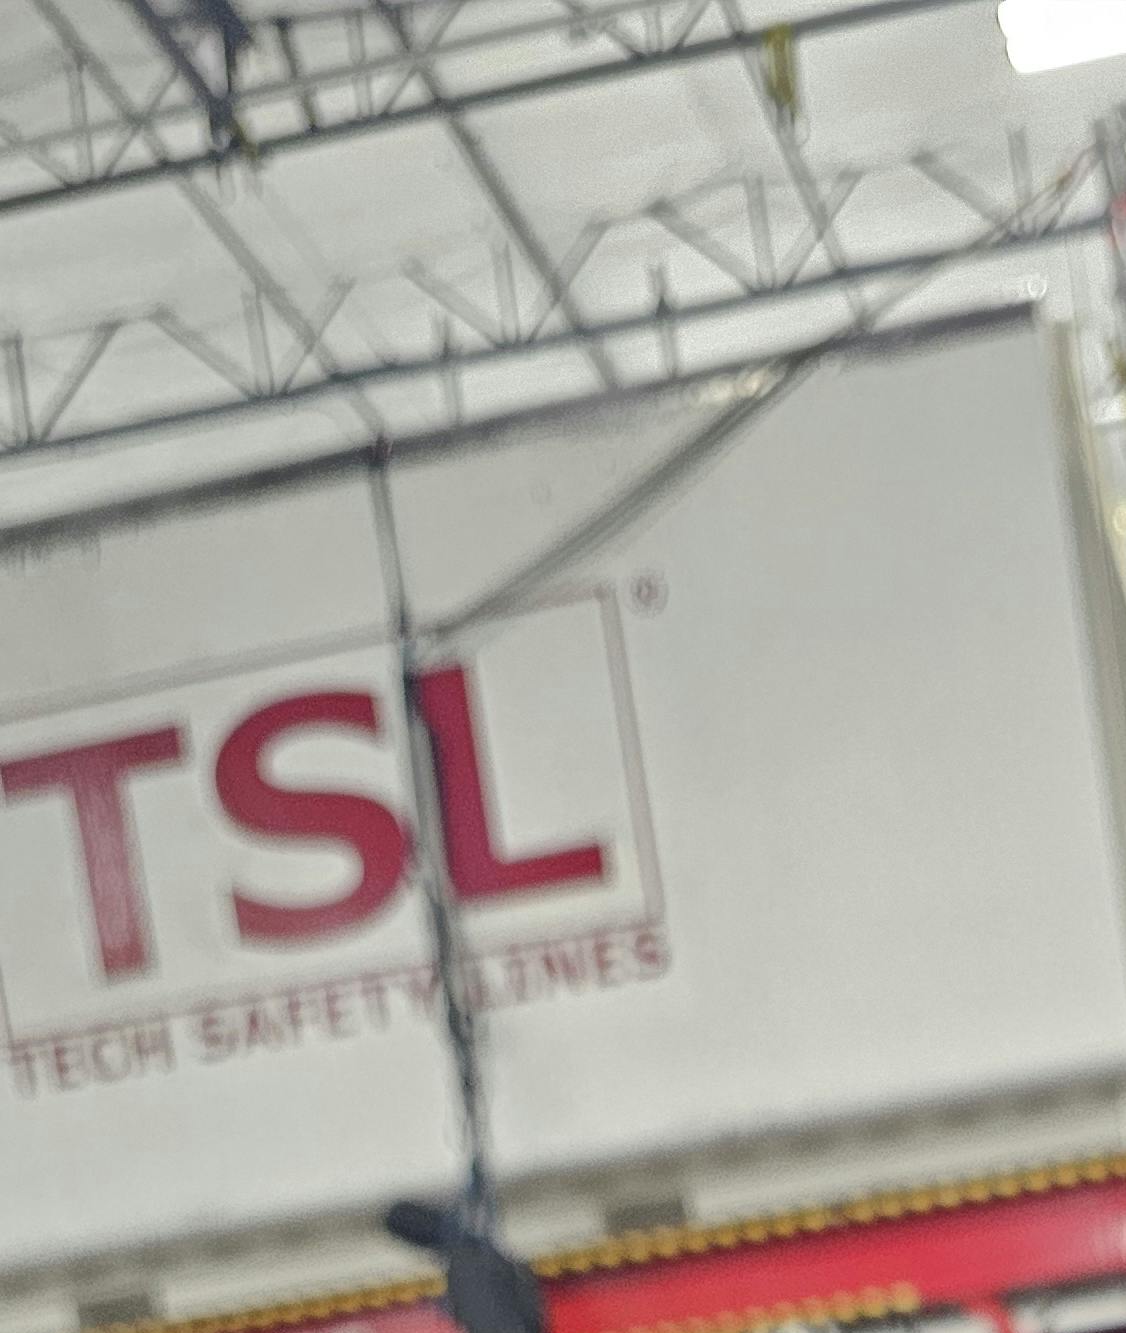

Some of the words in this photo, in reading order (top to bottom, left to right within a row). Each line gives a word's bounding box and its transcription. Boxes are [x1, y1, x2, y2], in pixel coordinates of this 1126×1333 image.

[0, 662, 606, 978] TSL
[8, 1020, 177, 1098] TECH
[198, 972, 442, 1066] SAFETY
